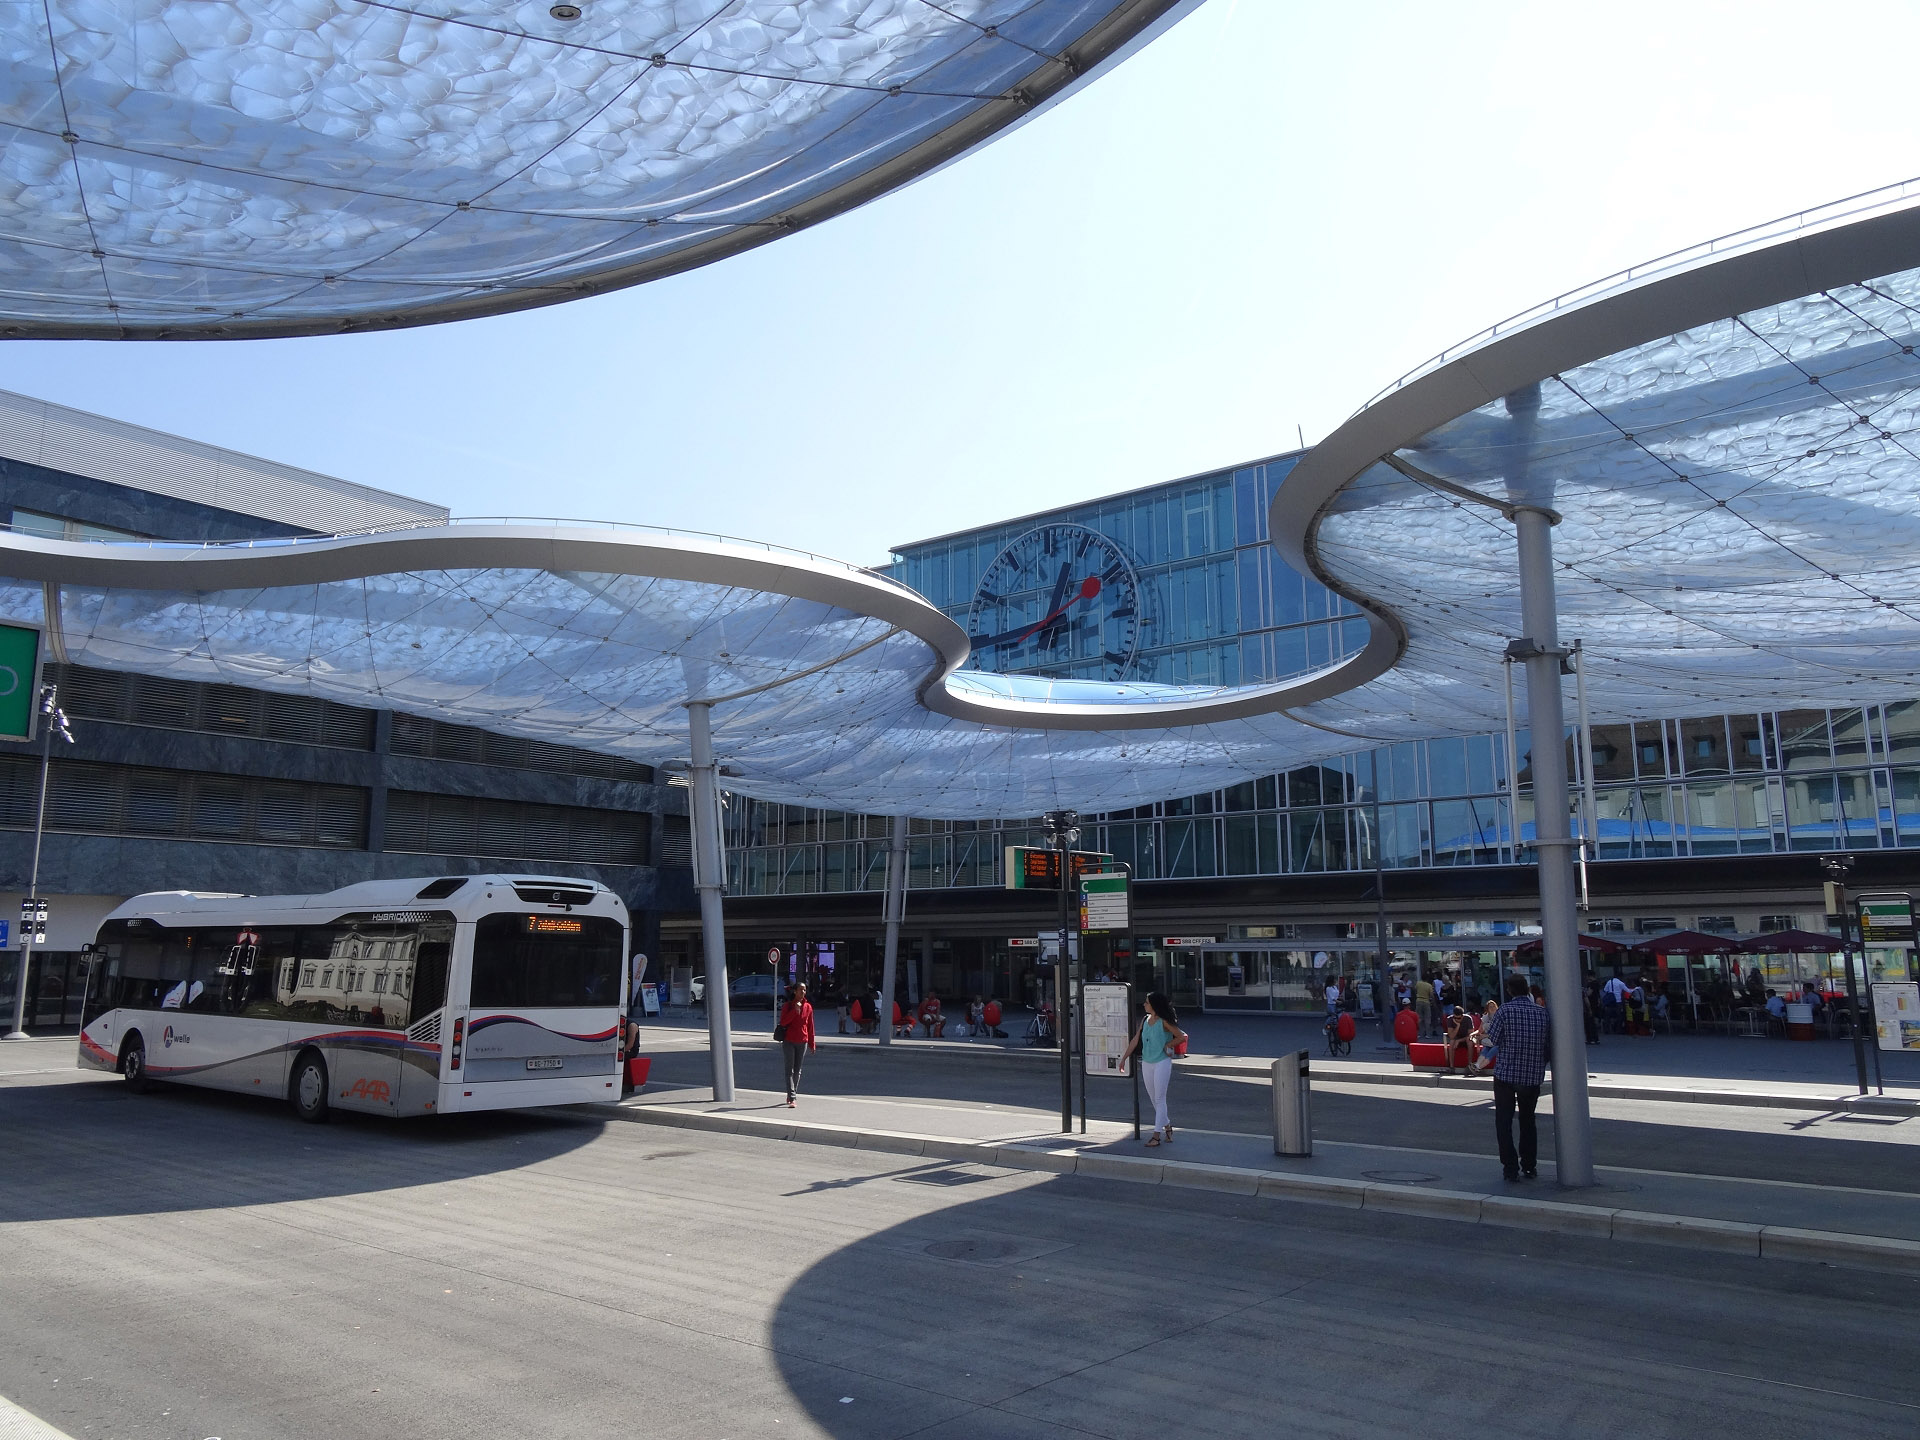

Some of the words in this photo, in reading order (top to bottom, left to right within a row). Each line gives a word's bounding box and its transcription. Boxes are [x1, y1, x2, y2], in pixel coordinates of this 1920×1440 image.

[1081, 881, 1089, 893] C
[1863, 906, 1871, 915] A
[372, 912, 402, 921] HYBRID
[529, 916, 536, 930] 7
